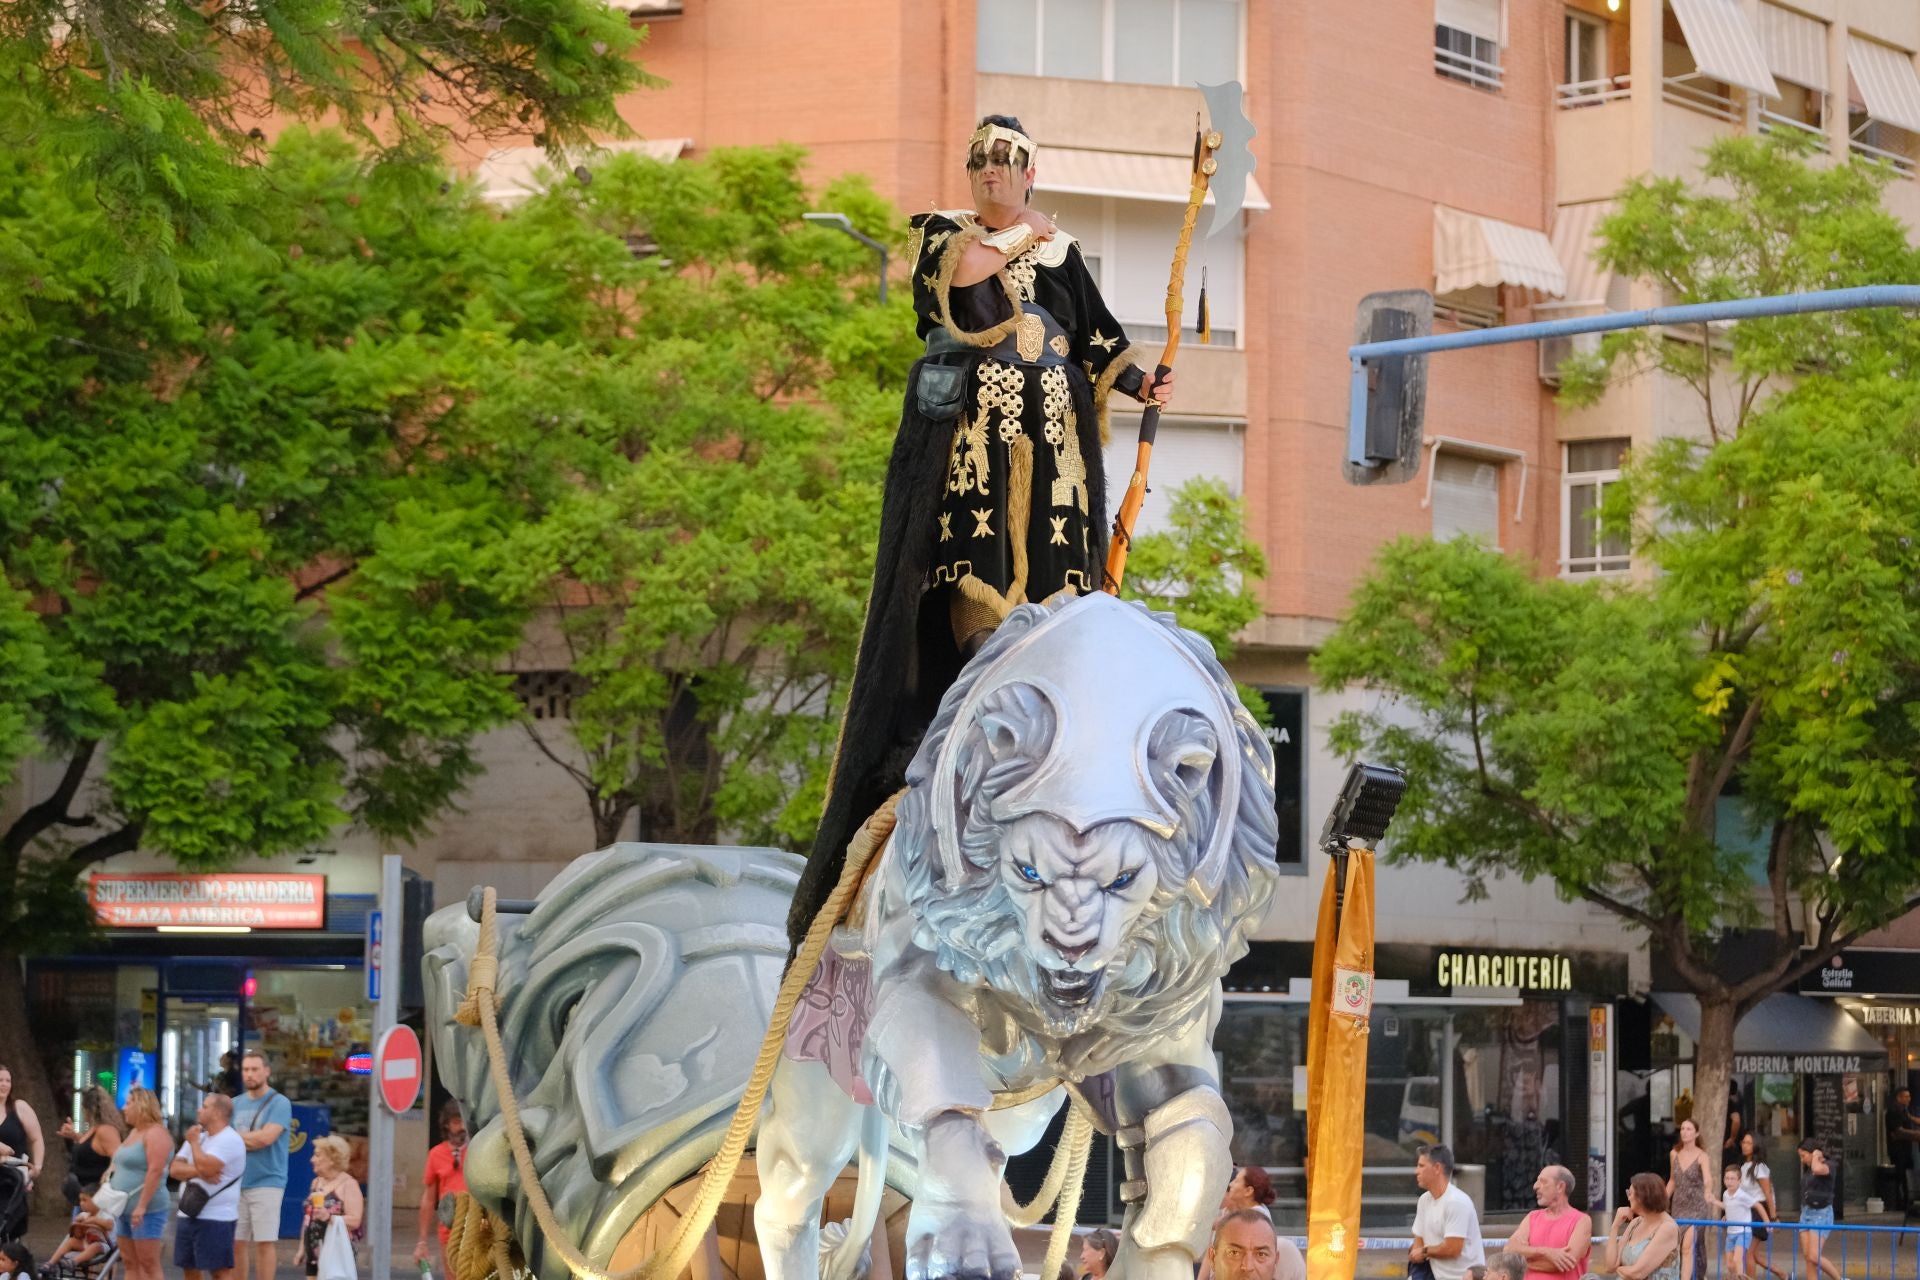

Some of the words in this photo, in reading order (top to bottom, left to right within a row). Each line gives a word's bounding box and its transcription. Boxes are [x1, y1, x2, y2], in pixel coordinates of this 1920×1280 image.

[113, 907, 172, 922] PLAZA
[1438, 953, 1571, 990] CHARCUTERÍA
[1821, 967, 1853, 978] Estrella
[1822, 977, 1852, 988] Galicia
[1862, 1007, 1912, 1025] TABERNA
[1734, 1056, 1789, 1072] TABERNA
[1794, 1056, 1860, 1072] MONTARAZ
